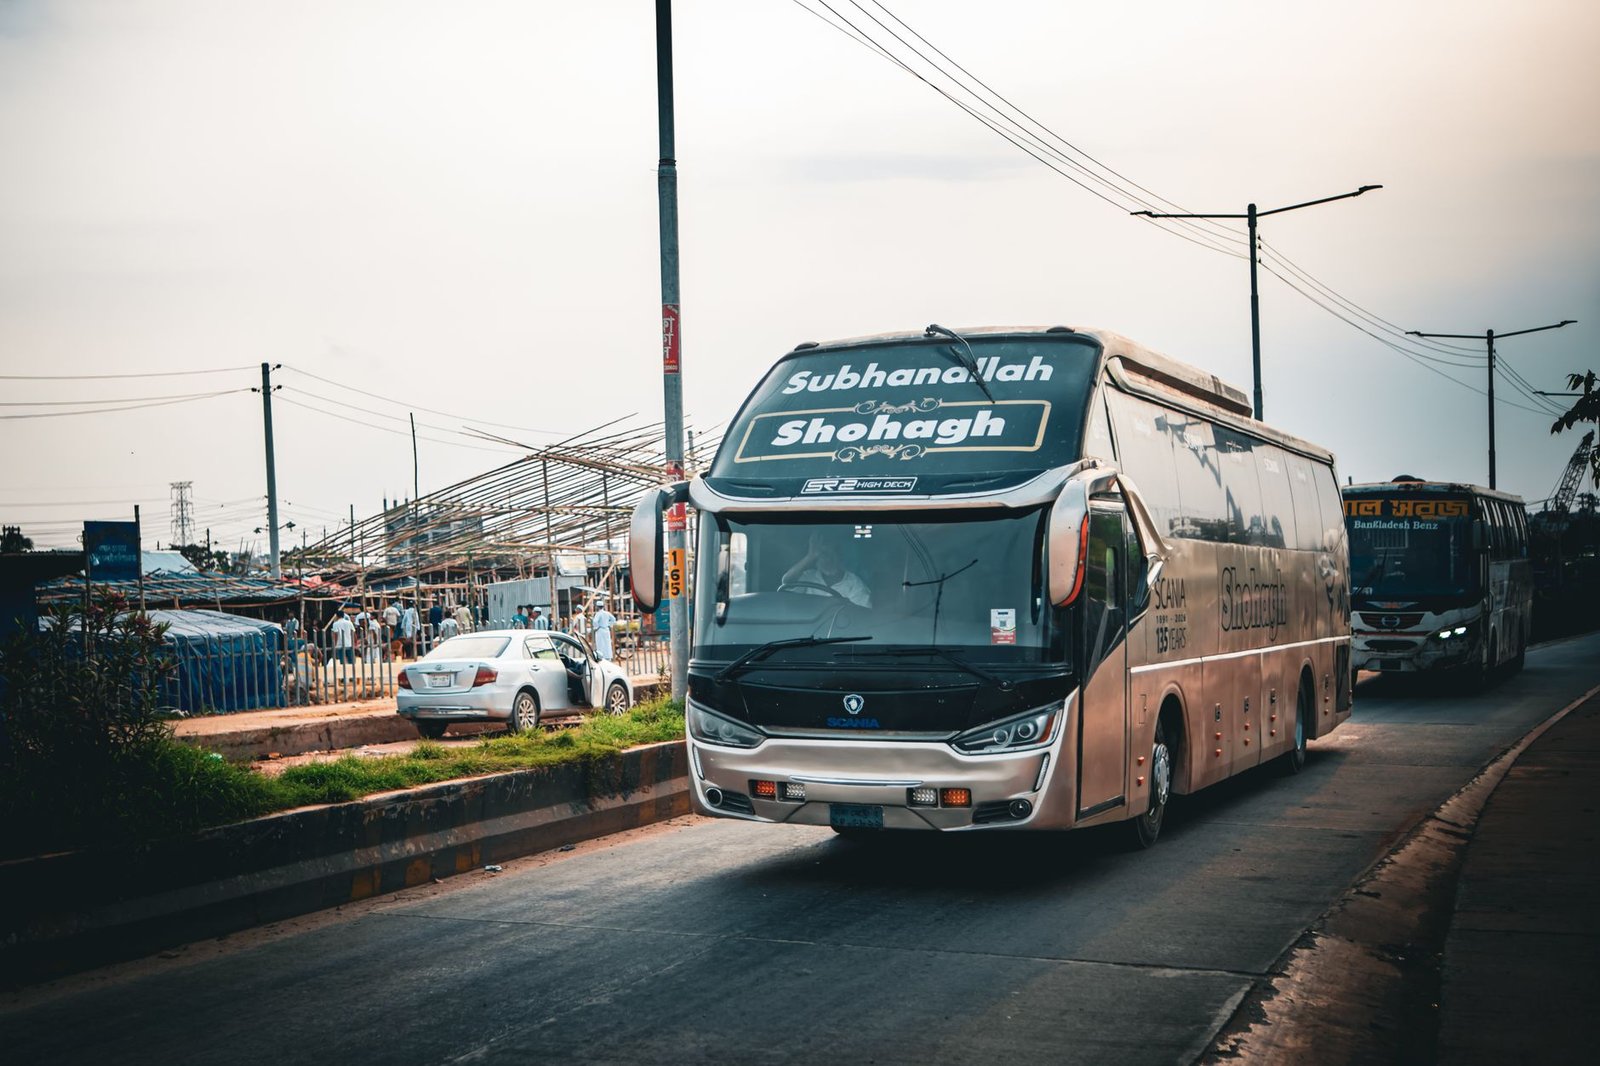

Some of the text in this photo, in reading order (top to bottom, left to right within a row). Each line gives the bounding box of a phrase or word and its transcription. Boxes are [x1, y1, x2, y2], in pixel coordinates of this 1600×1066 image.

[781, 356, 1054, 395] Subhanallah
[771, 410, 1006, 446] Shohagh
[1413, 521, 1438, 530] Benz
[1154, 577, 1186, 610] SCANIA
[1221, 566, 1287, 642] Shohagh
[1168, 628, 1186, 651] YEARS
[826, 717, 880, 729] SCANIA
